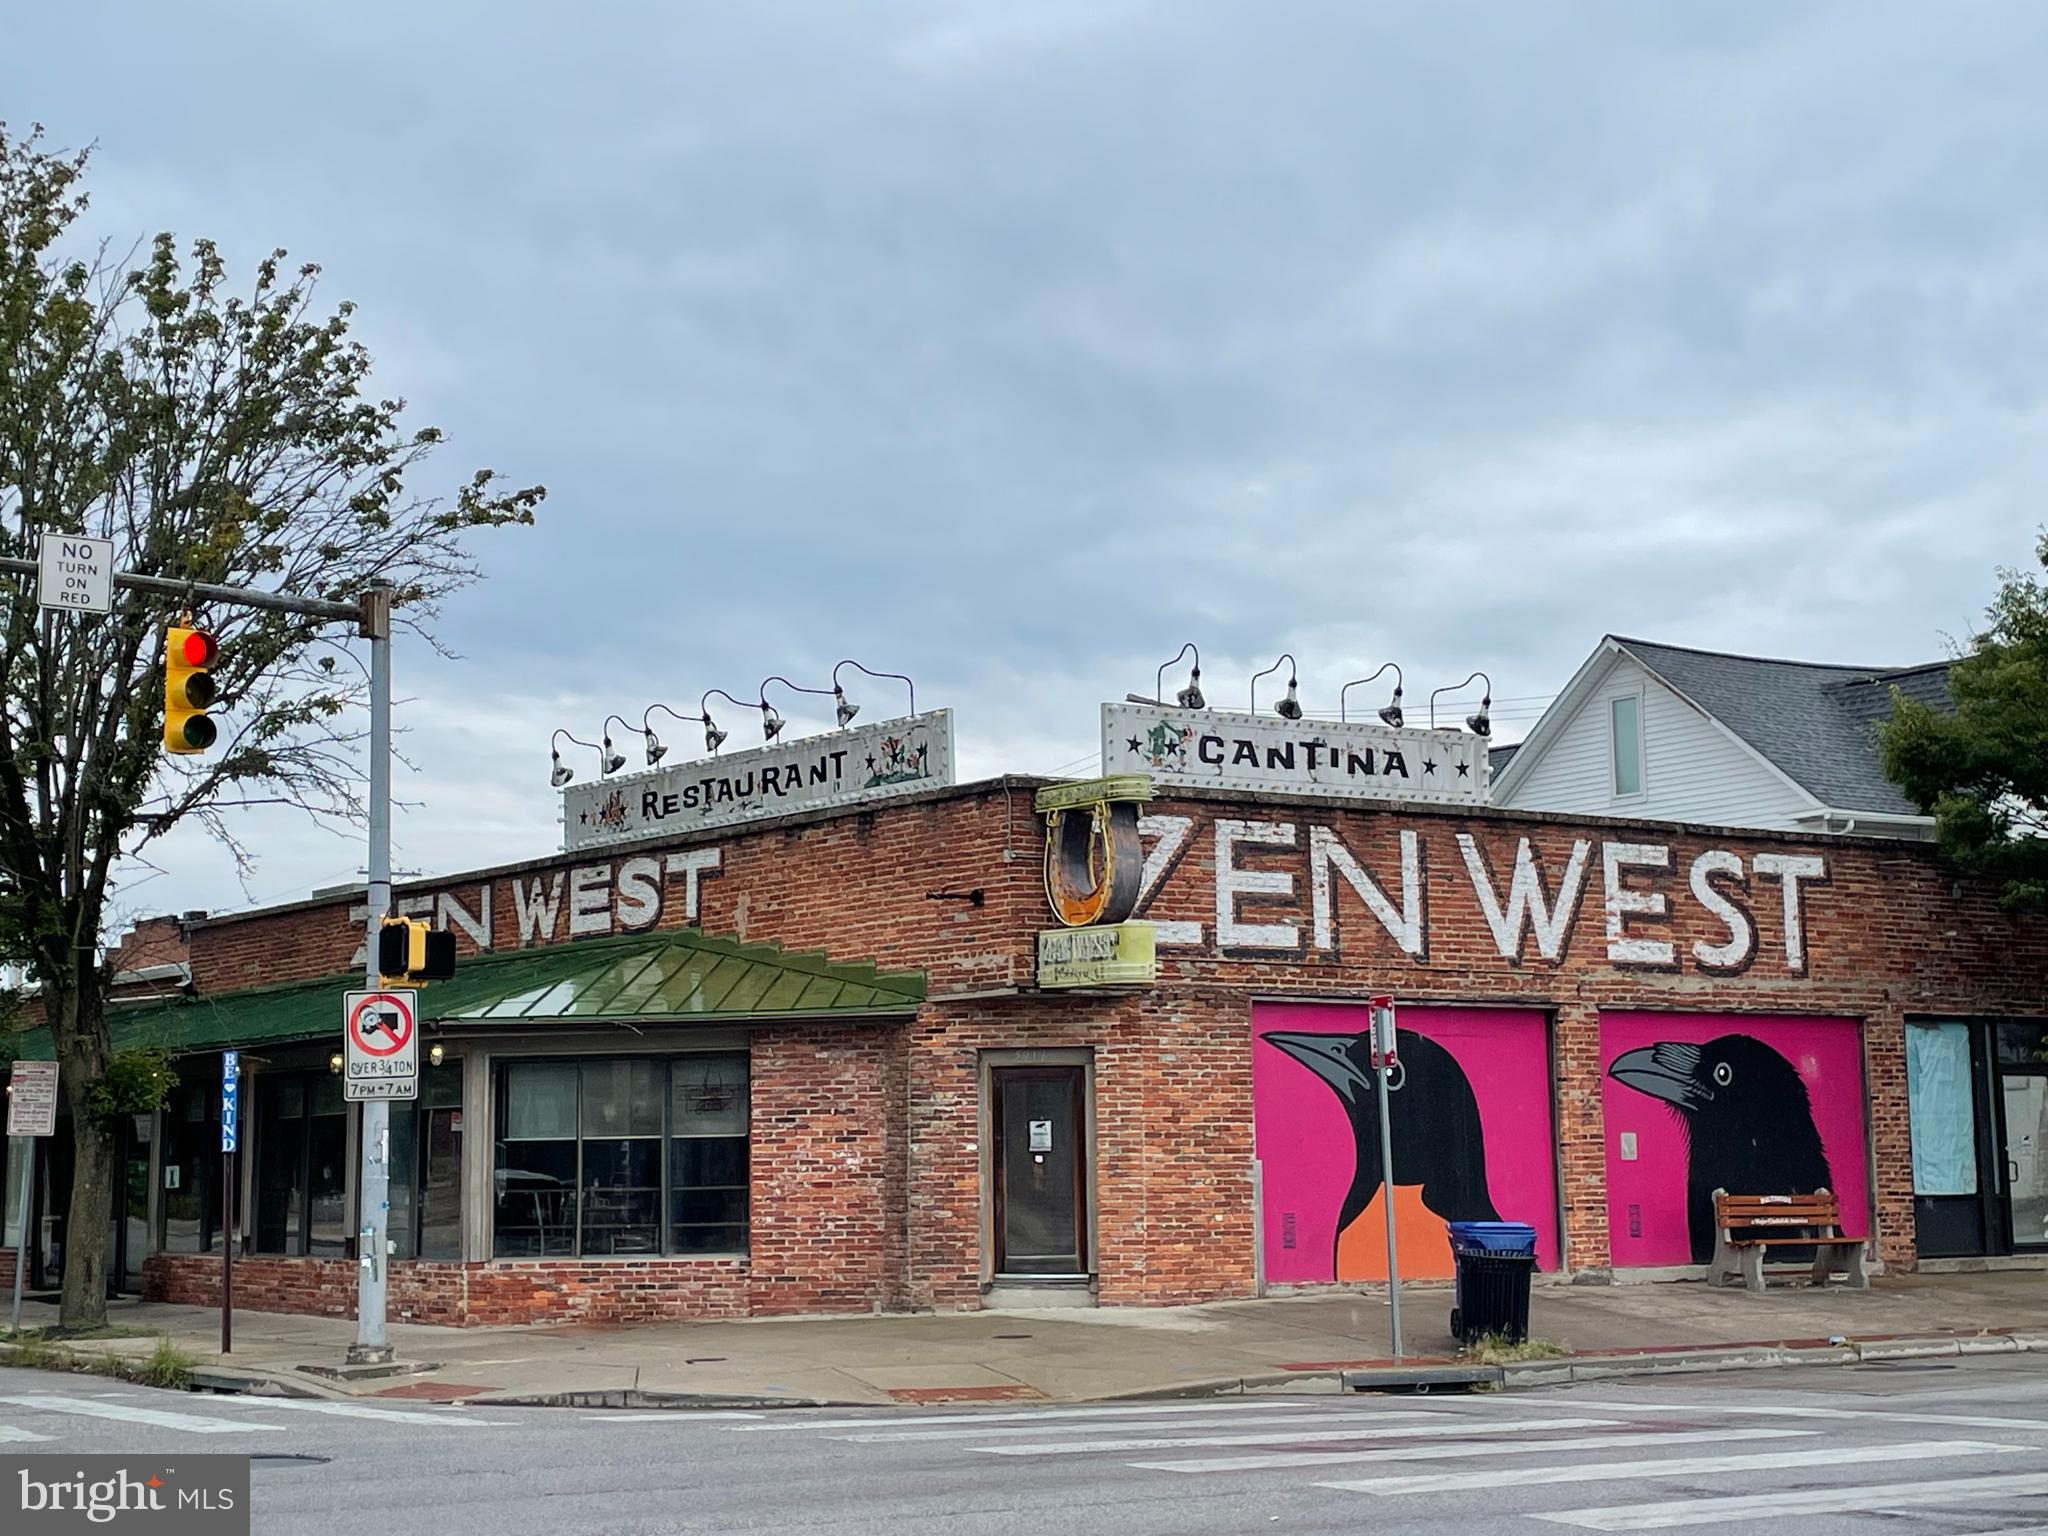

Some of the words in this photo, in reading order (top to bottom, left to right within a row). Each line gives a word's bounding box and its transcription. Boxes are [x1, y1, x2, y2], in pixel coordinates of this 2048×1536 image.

[62, 542, 92, 559] NO
[57, 561, 97, 575] TURN
[65, 577, 87, 589] ON
[60, 591, 90, 604] RED
[1199, 735, 1409, 778] CANTINA
[642, 751, 848, 819] RESTAURANT
[512, 847, 722, 942] WEST
[1134, 813, 1421, 957] ZEN
[1454, 831, 1826, 970] WEST
[224, 1053, 236, 1078] BE
[393, 1060, 412, 1073] TON
[222, 1098, 237, 1152] KIND
